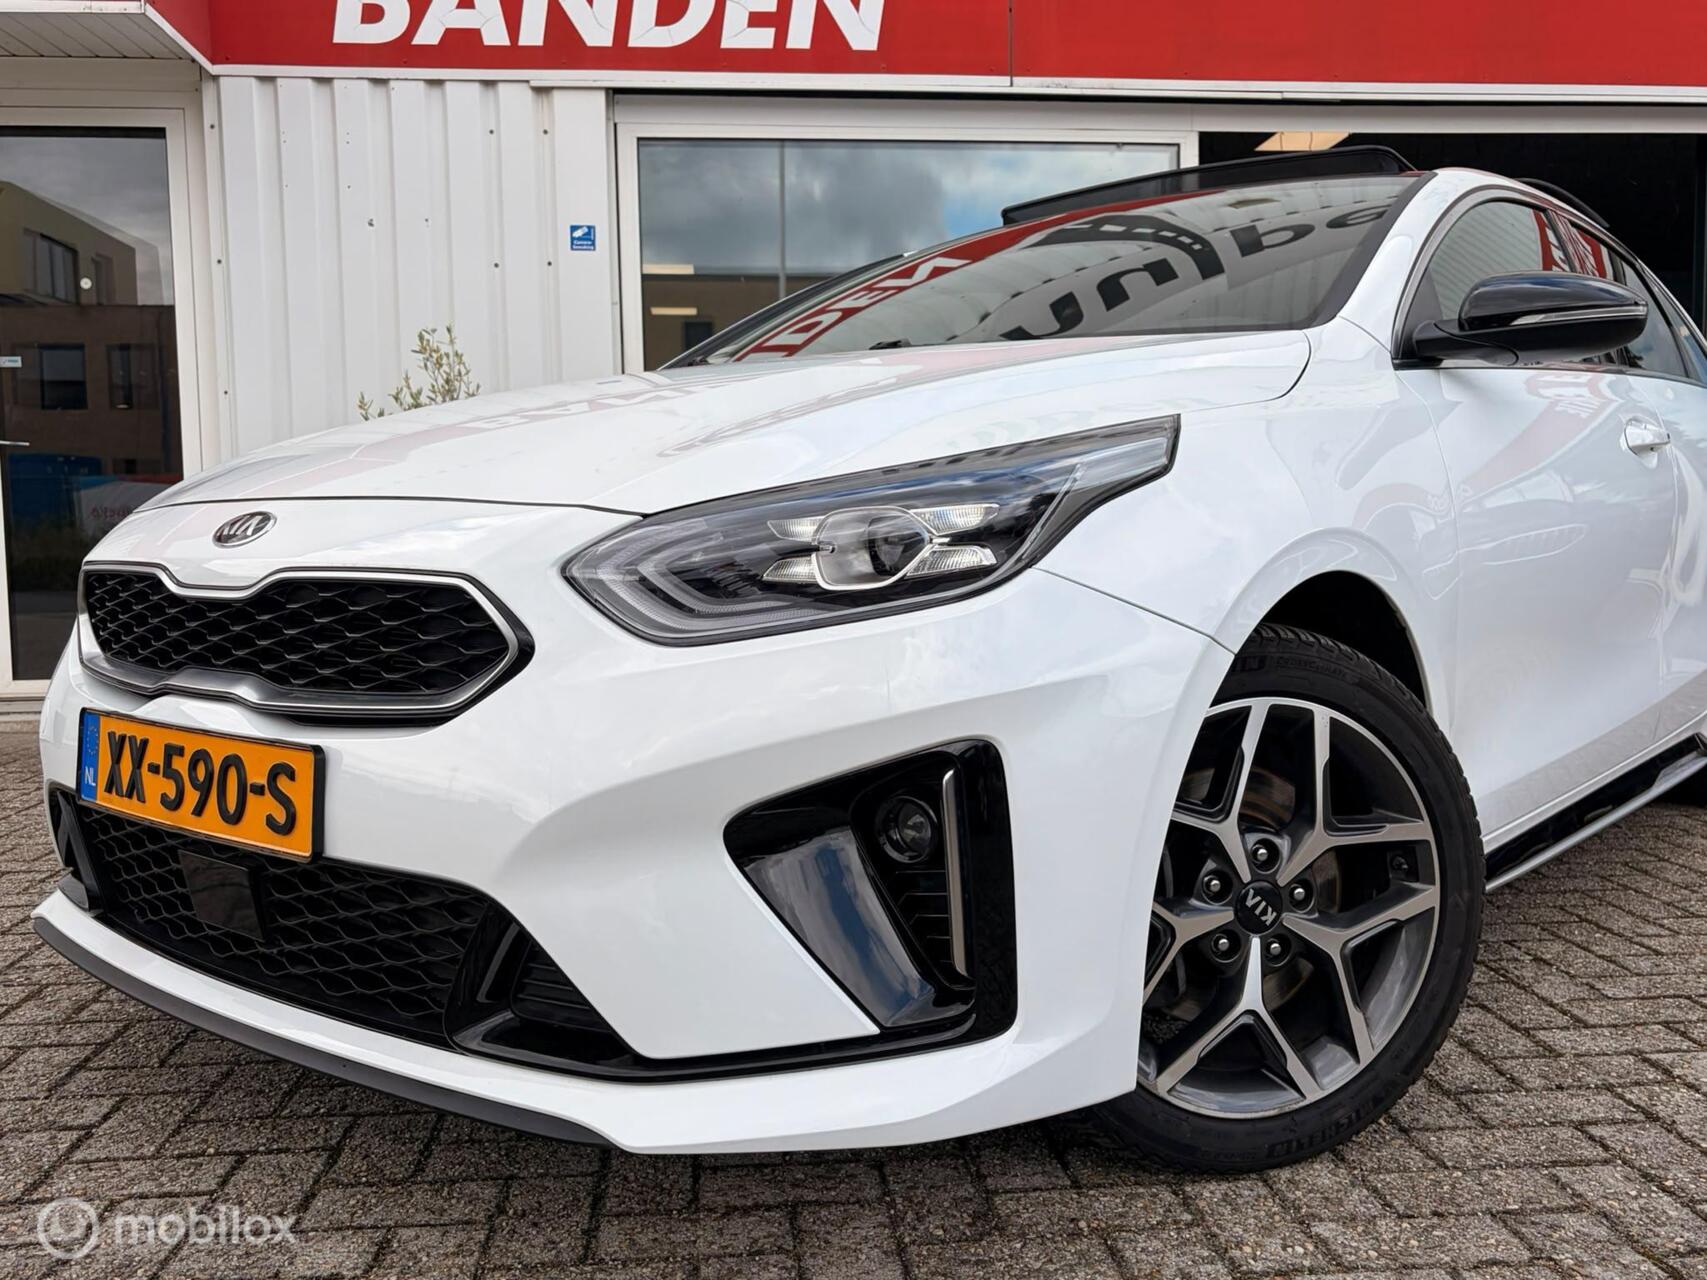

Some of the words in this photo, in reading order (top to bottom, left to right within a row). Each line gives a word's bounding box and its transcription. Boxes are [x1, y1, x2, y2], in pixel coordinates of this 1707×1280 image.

[332, 0, 885, 51] BANDEN
[84, 765, 97, 787] NL
[104, 730, 297, 836] XX-590-S
[1245, 888, 1277, 926] KIA
